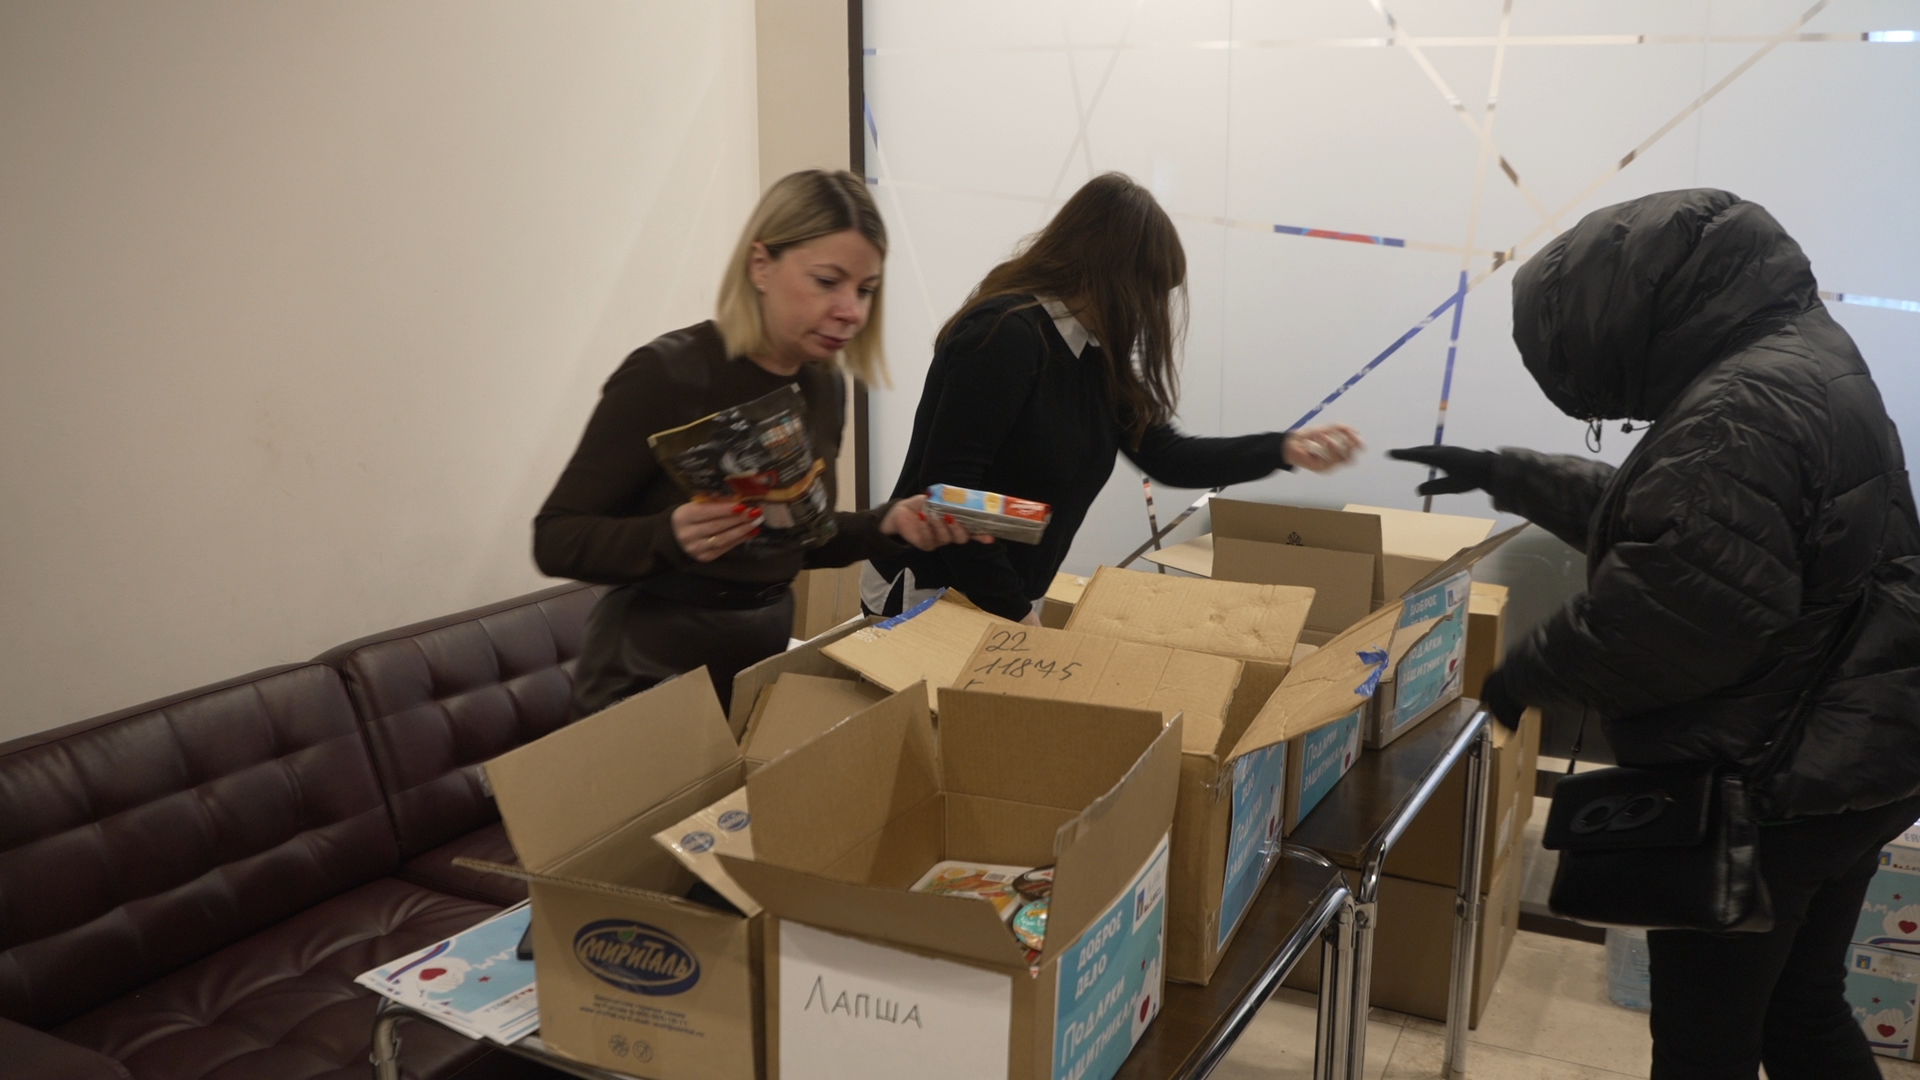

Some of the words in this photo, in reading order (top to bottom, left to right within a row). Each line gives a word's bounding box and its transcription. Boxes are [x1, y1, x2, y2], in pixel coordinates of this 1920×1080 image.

[985, 630, 1031, 652] 22
[1077, 909, 1123, 973] ДОБРОЕ
[1075, 953, 1108, 1001] ДЕЛО
